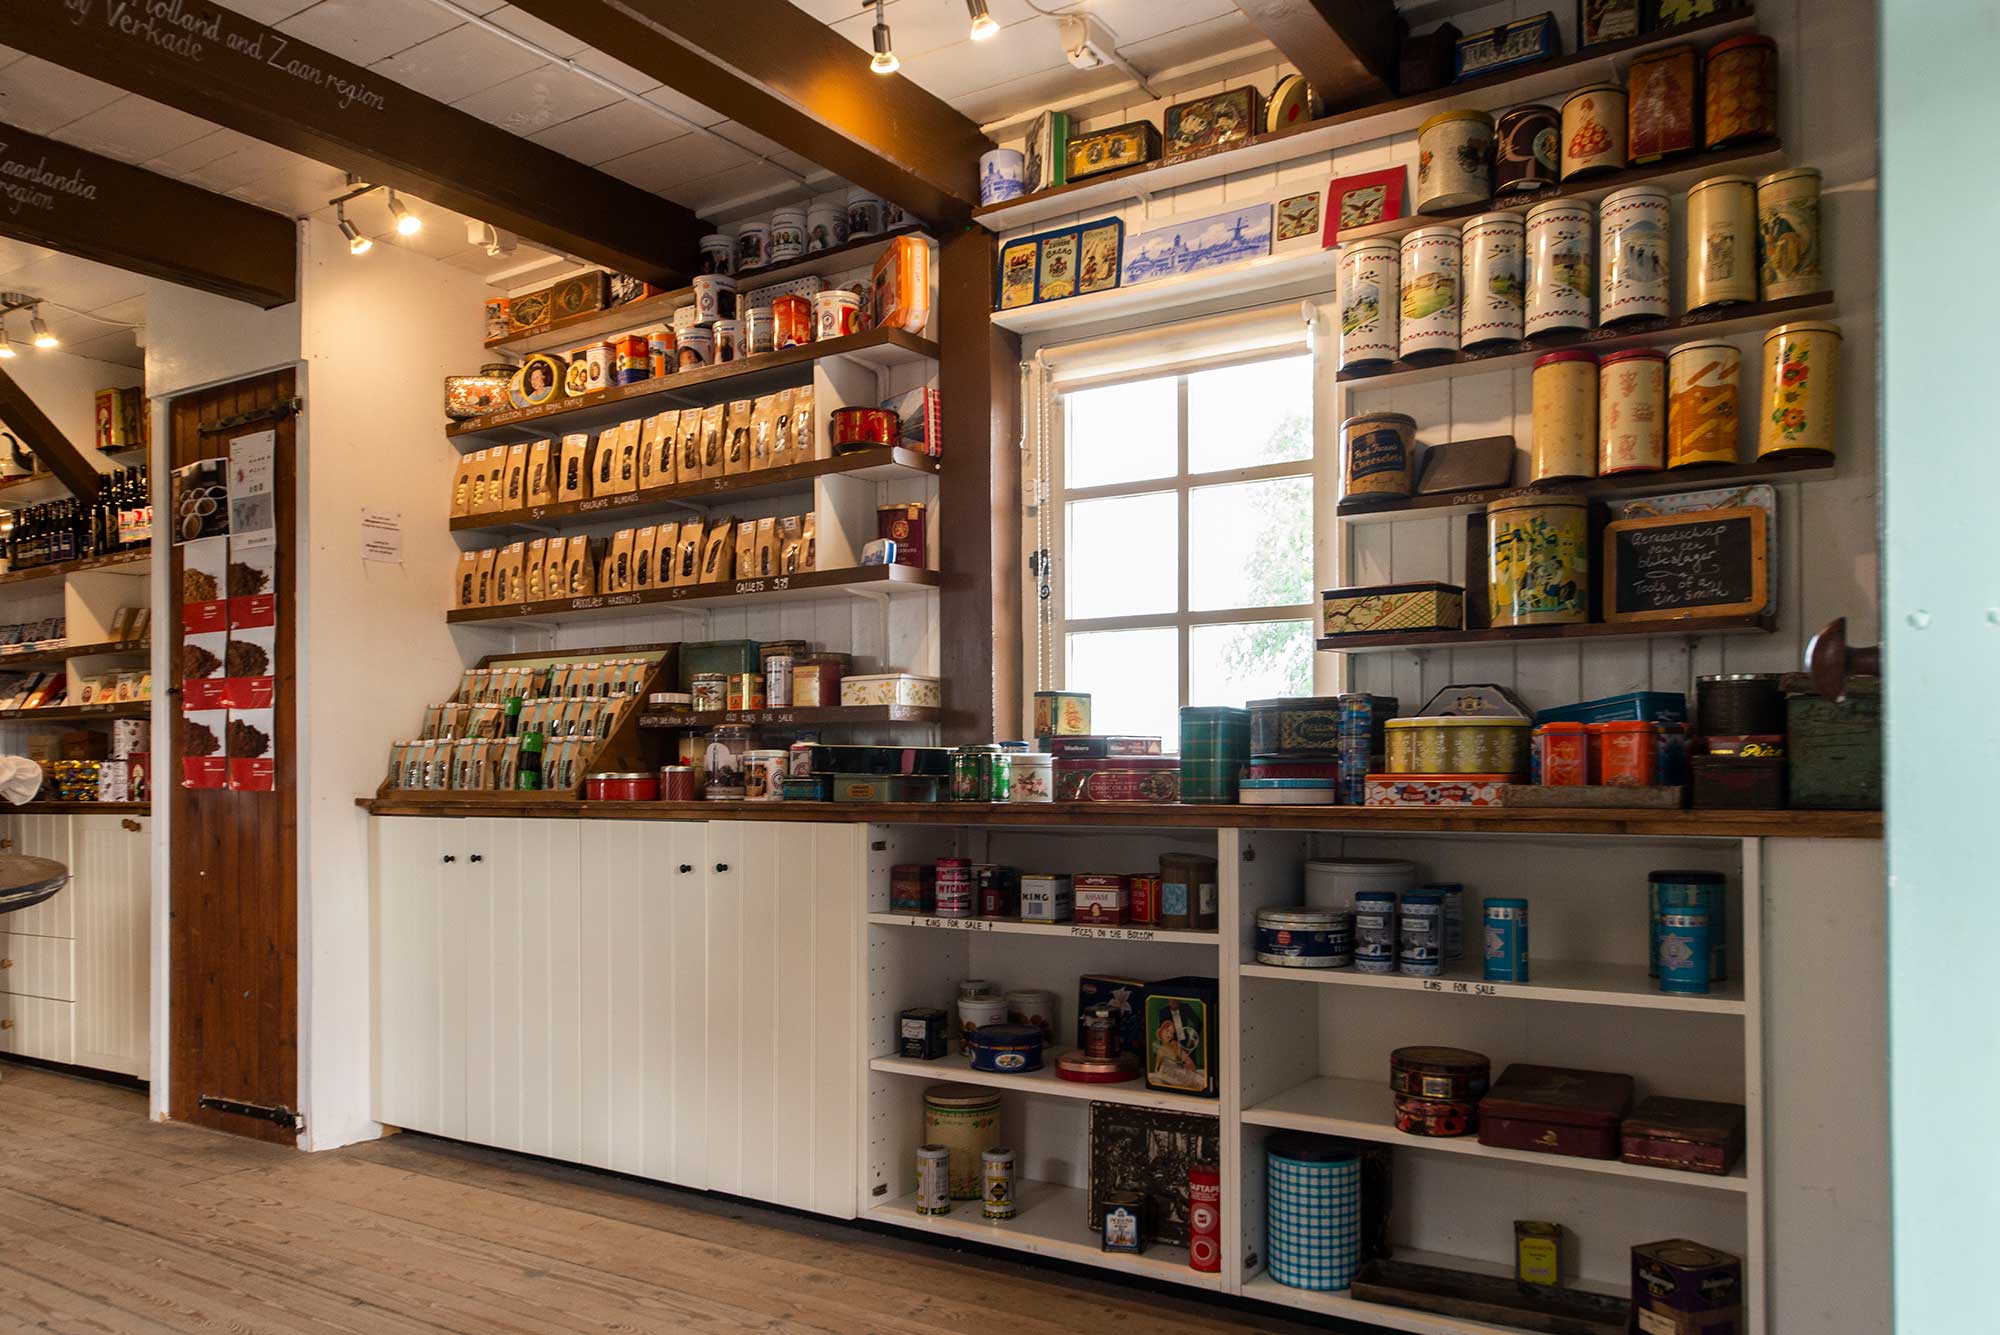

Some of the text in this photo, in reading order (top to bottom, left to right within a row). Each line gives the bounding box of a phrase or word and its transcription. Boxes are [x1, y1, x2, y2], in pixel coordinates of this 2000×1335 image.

[107, 2, 203, 62] Verkade
[131, 0, 384, 110] olland and Zaan region
[1046, 247, 1072, 258] CACAO
[1453, 494, 1483, 505] DUTCH
[726, 713, 736, 722] OLD
[762, 712, 773, 721] FOR
[778, 713, 793, 722] SALE
[1022, 893, 1049, 901] KING
[947, 919, 959, 928] FOR
[965, 920, 982, 930] SALE
[1453, 982, 1468, 993] FOR
[1475, 984, 1496, 996] SALE
